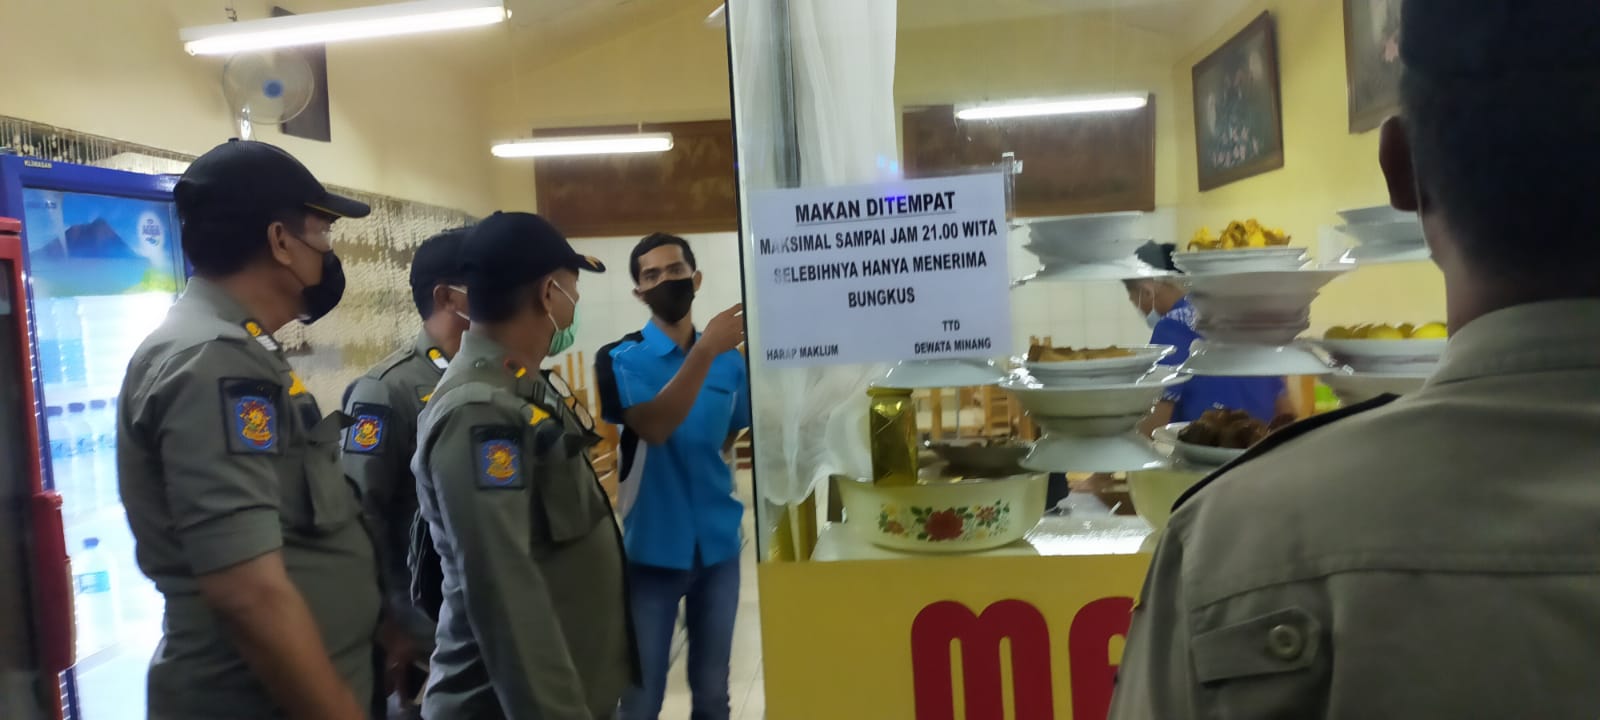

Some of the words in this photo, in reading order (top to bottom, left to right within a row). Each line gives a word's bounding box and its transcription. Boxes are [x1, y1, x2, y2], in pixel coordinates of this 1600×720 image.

[795, 200, 861, 223] MAKAN
[866, 191, 956, 217] DITEMPAT
[760, 233, 832, 255] MAKSIMAL
[835, 229, 886, 249] SAMPAI
[890, 225, 918, 244] JAM
[922, 222, 959, 242] 21.00
[962, 219, 998, 238] WITA
[774, 261, 859, 284] SELEBIHNYA
[862, 255, 910, 277] HANYA
[913, 251, 988, 273] MENERIMA
[848, 287, 916, 308] BUNGKUS
[942, 319, 961, 331] TTD
[766, 347, 797, 361] HARAP
[799, 343, 839, 358] MAKLUM
[914, 340, 952, 354] DEWATA
[954, 337, 992, 351] MINANG
